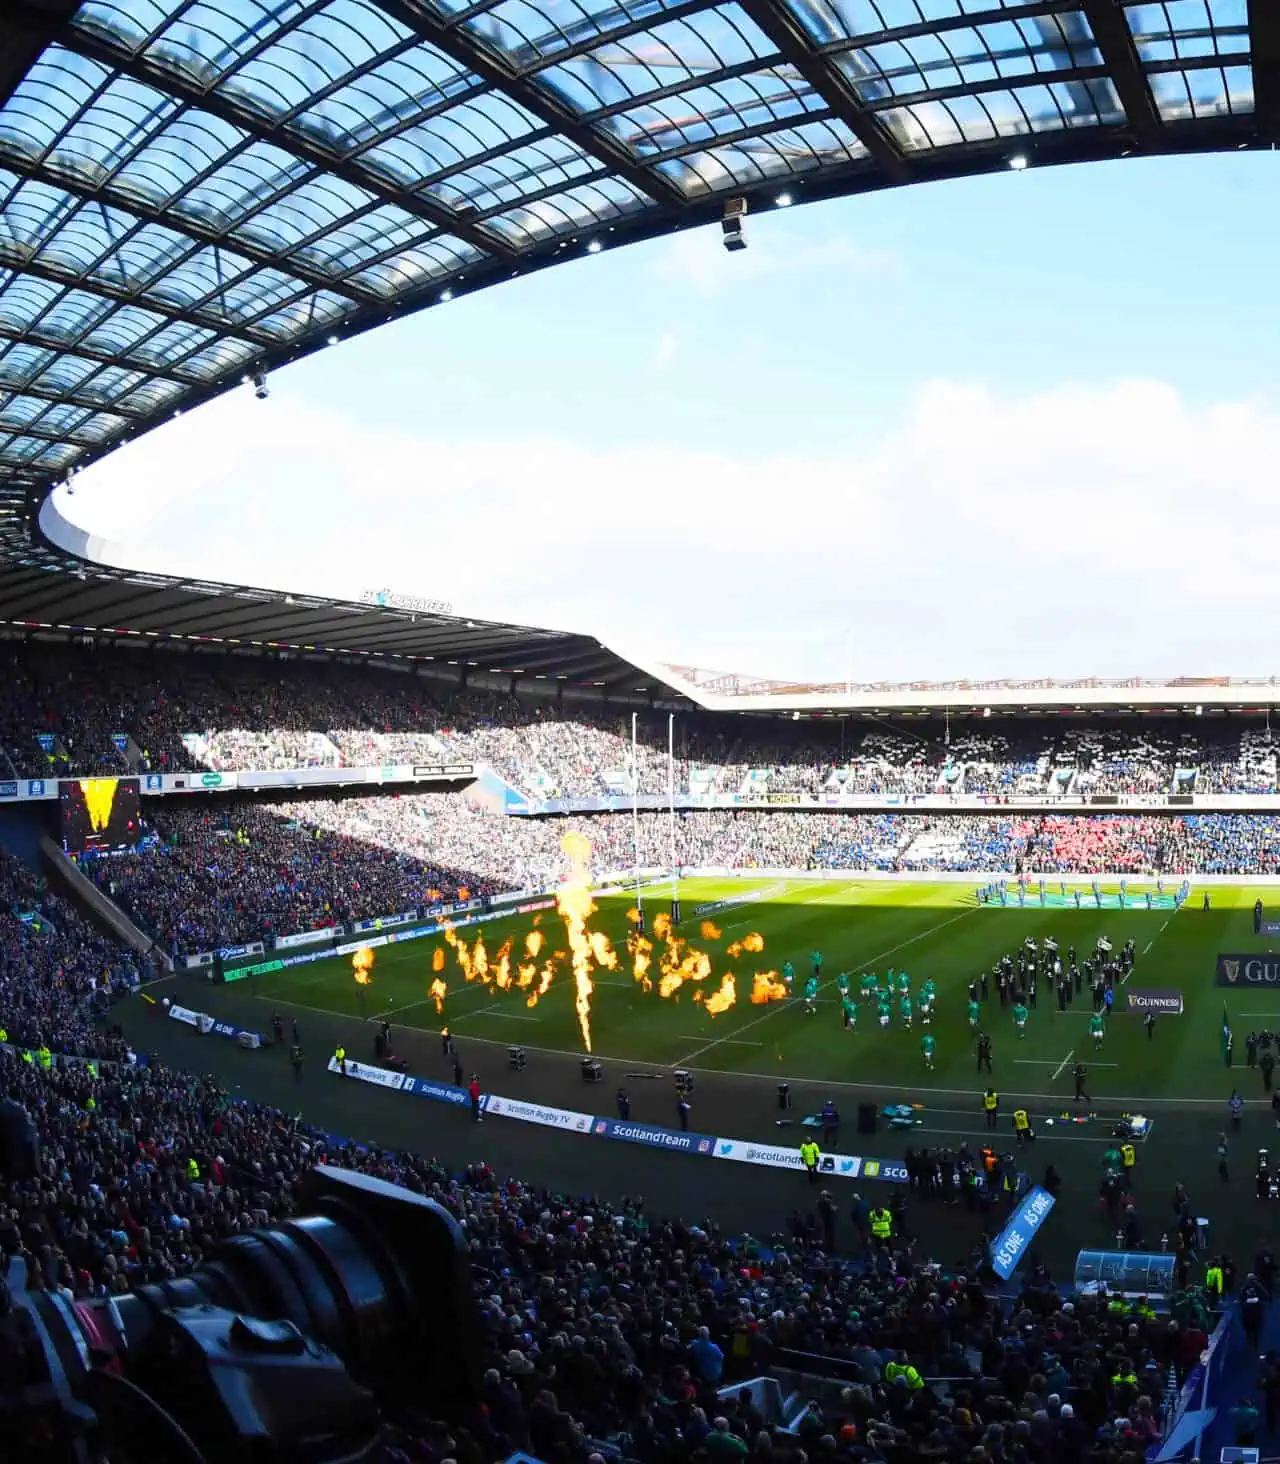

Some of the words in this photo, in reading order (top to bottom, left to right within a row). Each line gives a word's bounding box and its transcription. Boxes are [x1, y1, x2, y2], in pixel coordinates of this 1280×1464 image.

[420, 1084, 445, 1097] Scottish
[446, 1090, 466, 1103] Rugby
[507, 1103, 535, 1117] Scottish
[535, 1109, 559, 1123] Rugby
[613, 1125, 690, 1147] ScotlandTeam
[1031, 1193, 1049, 1215] ONE
[1024, 1209, 1039, 1227] AS
[1004, 1229, 1025, 1254] ONE
[997, 1249, 1013, 1269] AS
